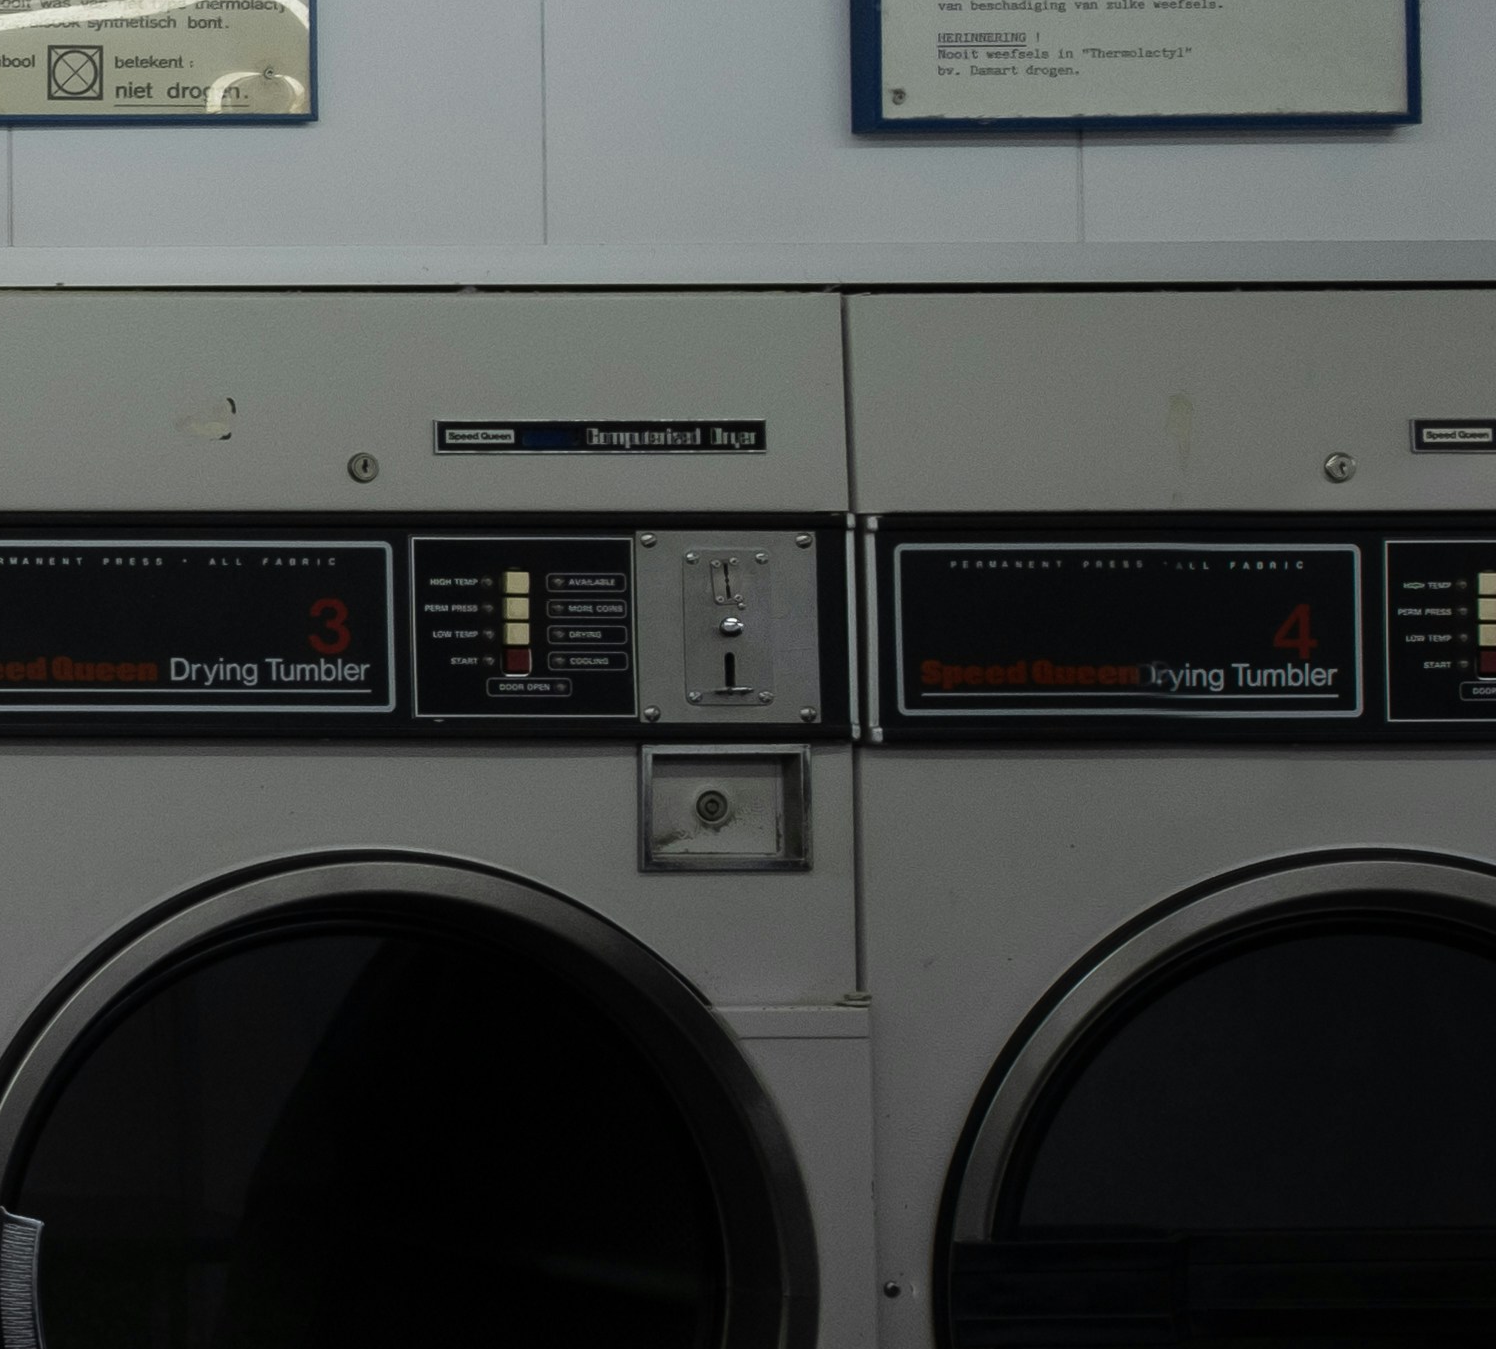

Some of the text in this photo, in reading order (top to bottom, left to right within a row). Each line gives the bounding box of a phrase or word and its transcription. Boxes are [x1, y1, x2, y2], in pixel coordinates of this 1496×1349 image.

[938, 0, 963, 12] van
[970, 0, 1066, 14] beschadiging
[1073, 0, 1099, 11] van
[937, 32, 1027, 44] HERINNERING
[115, 83, 153, 99] niet
[103, 558, 164, 567] PRESS
[209, 558, 243, 567] ALL
[308, 598, 351, 654] 3
[1273, 603, 1318, 660] 4
[51, 657, 158, 682] Queen
[170, 658, 257, 686] Drying
[265, 658, 370, 682] Tumbler
[920, 659, 1139, 691] Speed Queen
[1231, 663, 1338, 688] Tumbler
